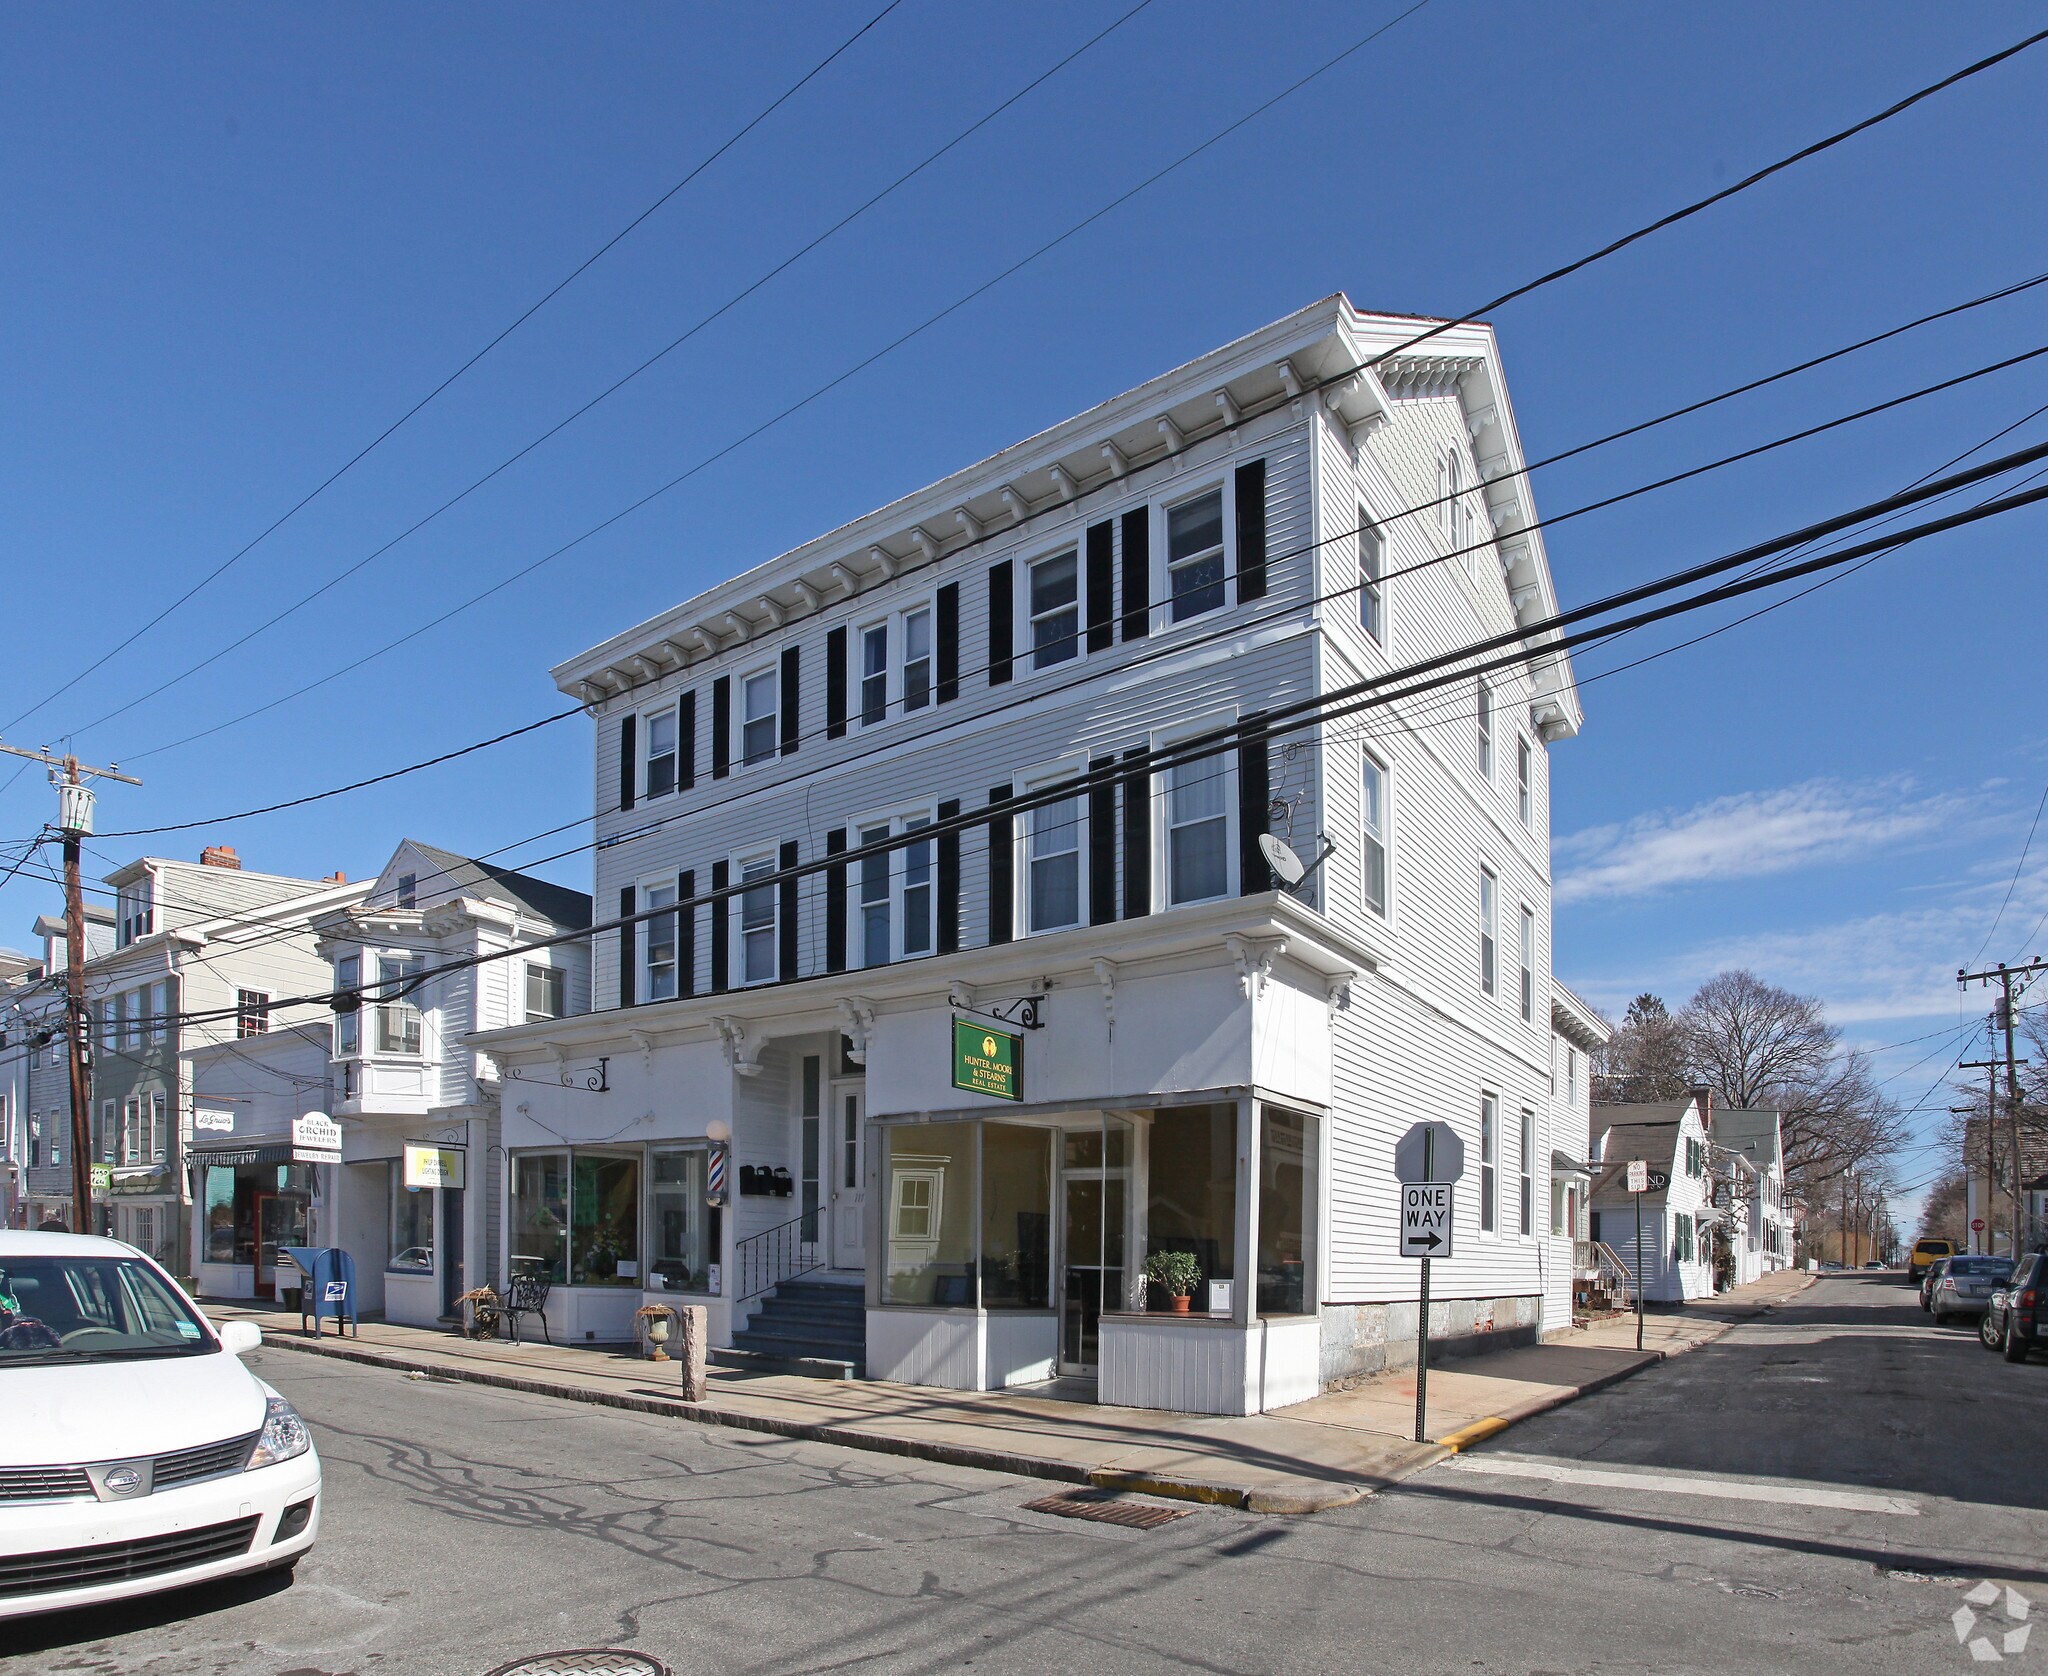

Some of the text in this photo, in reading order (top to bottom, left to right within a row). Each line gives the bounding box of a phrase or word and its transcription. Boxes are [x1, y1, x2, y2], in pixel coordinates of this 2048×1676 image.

[972, 1067, 1006, 1083] & STEARNS
[992, 1062, 1013, 1075] MOORE
[972, 1078, 1006, 1092] REAL ESTATE
[306, 1119, 329, 1127] BLACK
[298, 1125, 337, 1137] ORCHID
[299, 1135, 337, 1144] JEWELERS
[1633, 1163, 1641, 1171] NO
[1408, 1189, 1446, 1207] ONE
[1406, 1210, 1446, 1227] WAY
